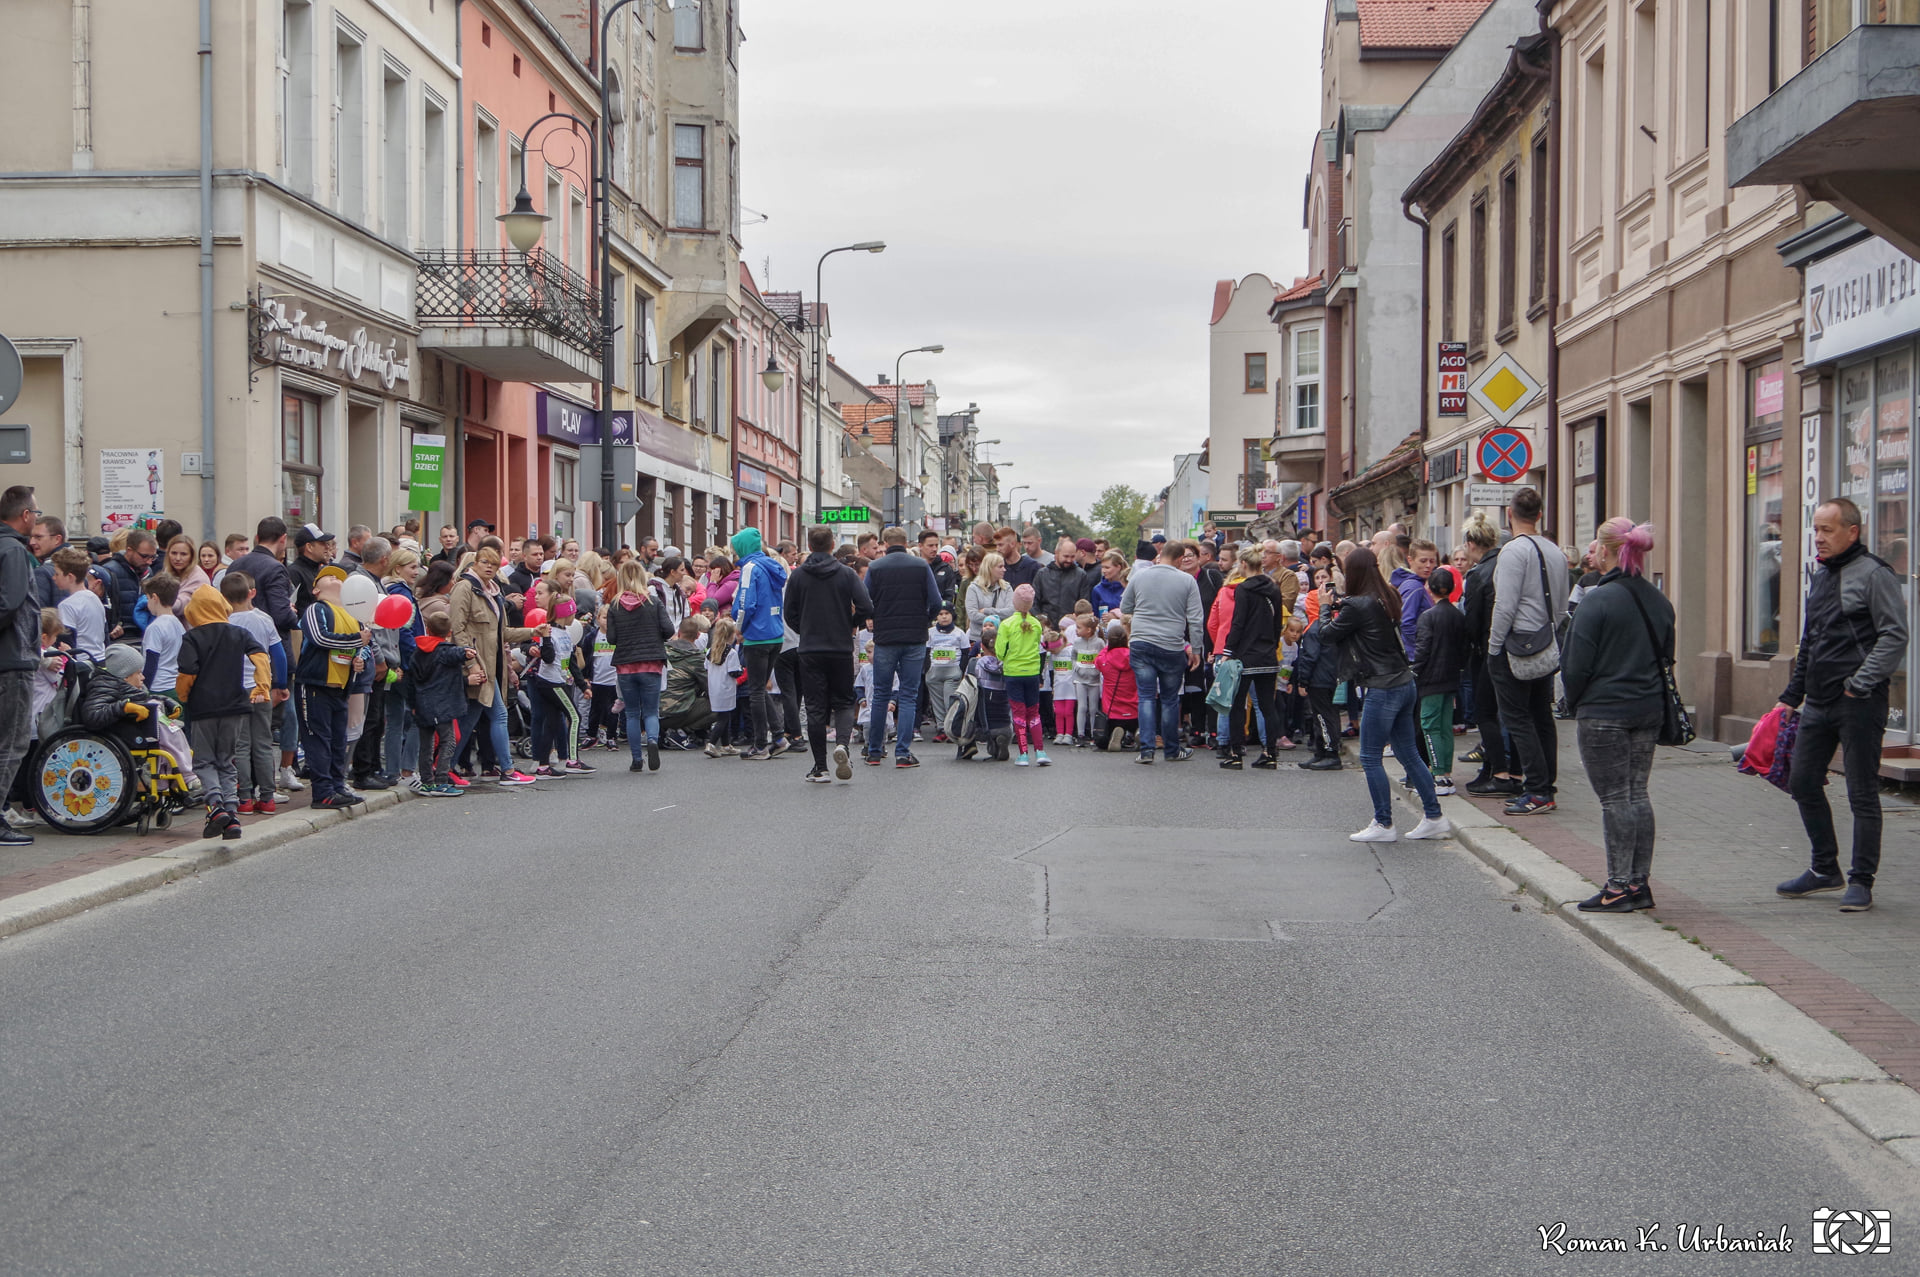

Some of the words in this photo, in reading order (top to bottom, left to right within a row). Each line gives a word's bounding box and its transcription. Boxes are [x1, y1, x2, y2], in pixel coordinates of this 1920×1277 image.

[1827, 273, 1872, 327] KASEJA
[1876, 258, 1919, 309] MEBL
[1440, 356, 1466, 367] AGD
[1441, 397, 1465, 408] RTV
[561, 407, 582, 435] PLAY
[415, 453, 440, 462] START
[414, 462, 439, 471] DZIECI
[1804, 418, 1819, 600] UPOMIN
